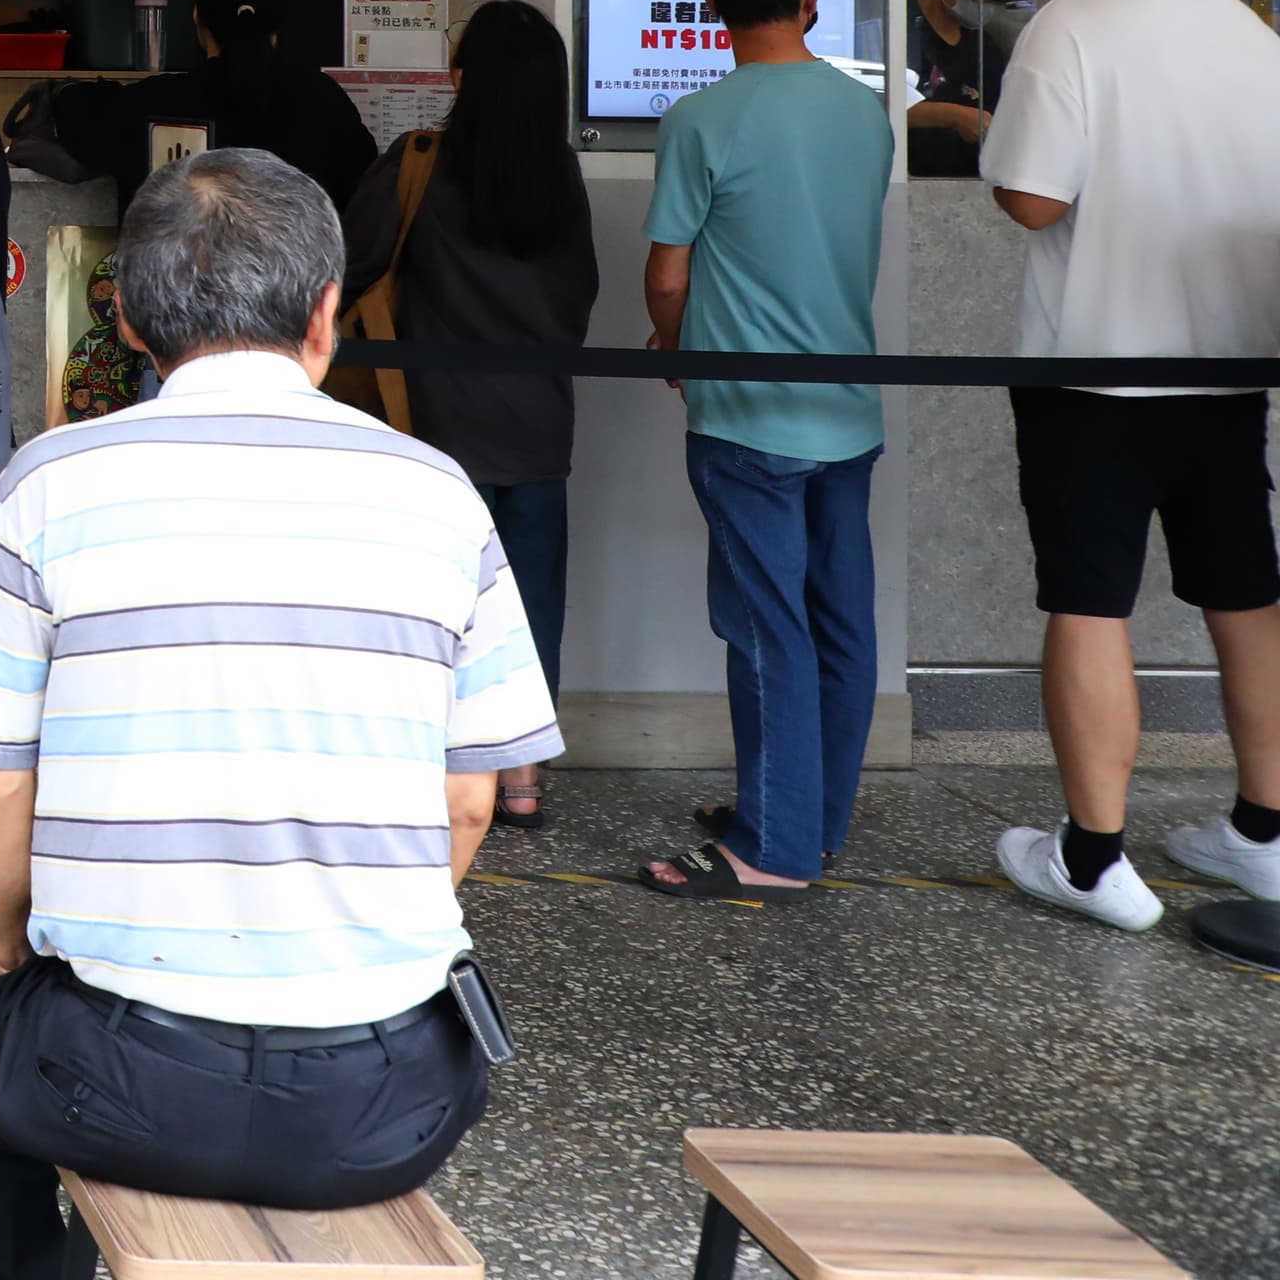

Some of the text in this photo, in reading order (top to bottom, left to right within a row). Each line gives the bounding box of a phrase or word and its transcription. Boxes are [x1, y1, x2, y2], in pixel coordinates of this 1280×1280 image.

[373, 17, 422, 27] 今日已售完
